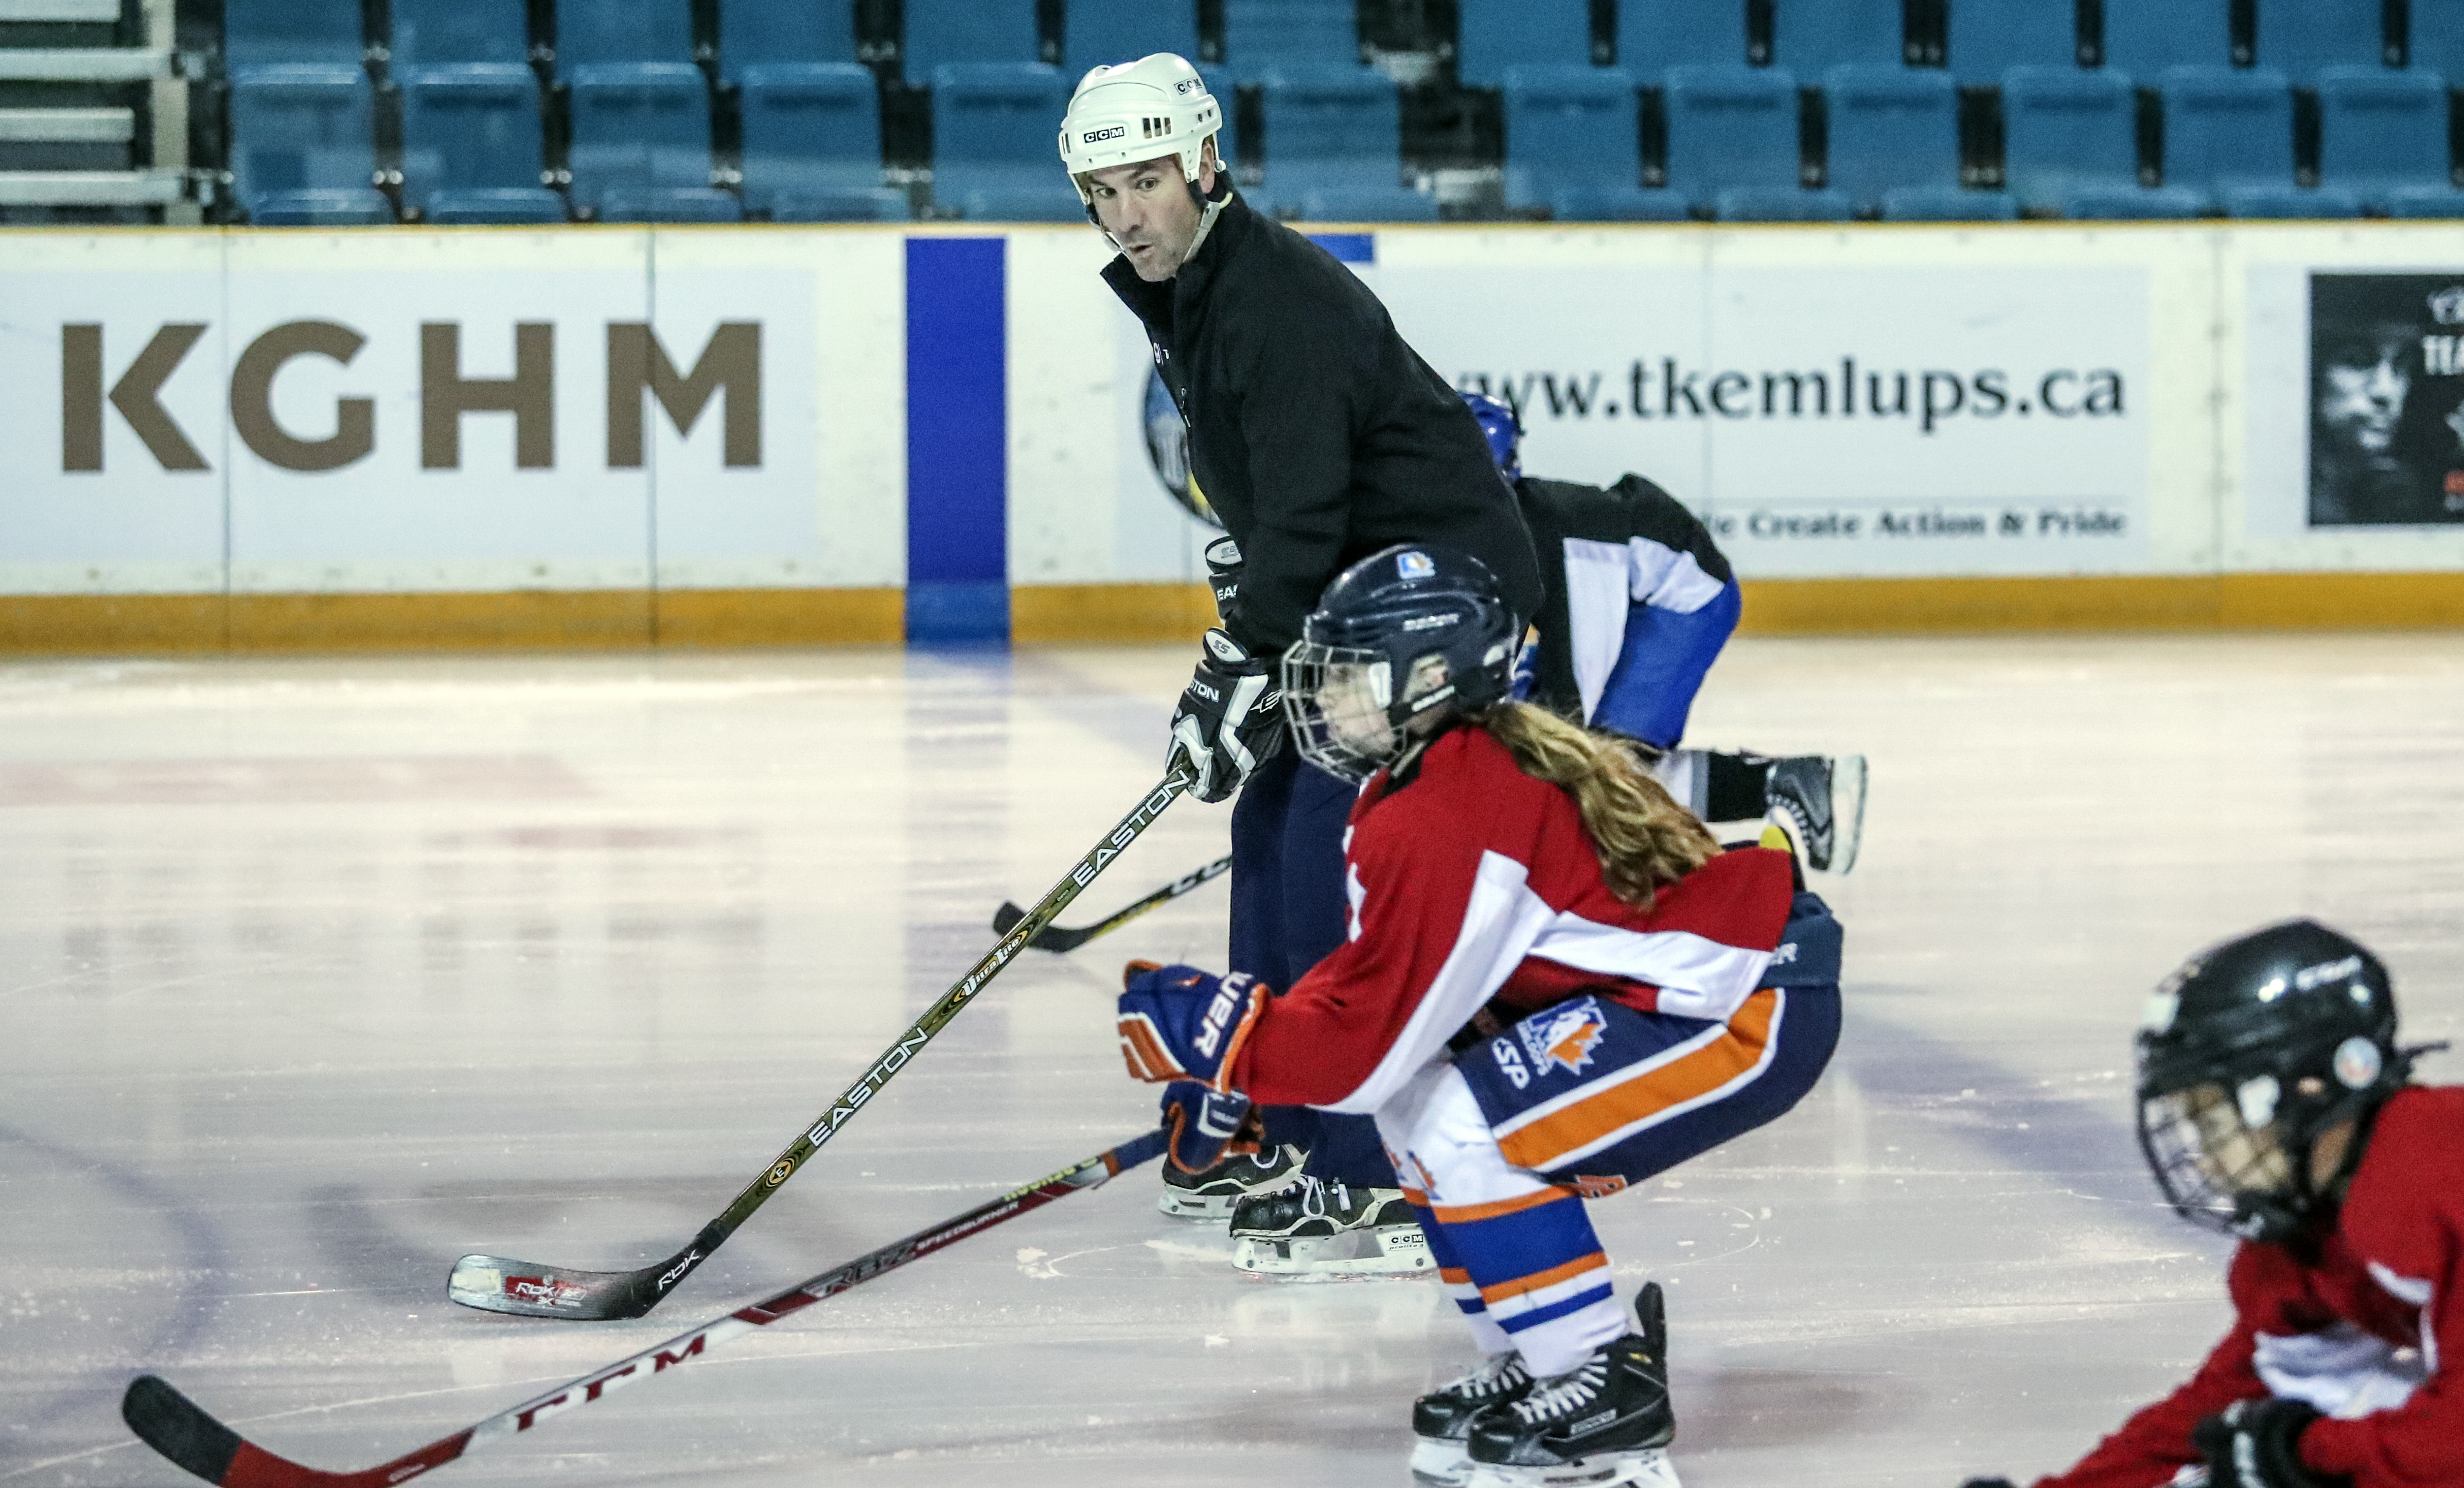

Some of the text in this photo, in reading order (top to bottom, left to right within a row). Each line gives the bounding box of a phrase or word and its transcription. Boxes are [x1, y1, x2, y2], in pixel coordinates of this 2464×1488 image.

[1174, 77, 1202, 95] CCM
[1084, 127, 1124, 144] CCM
[62, 316, 763, 472] KGHM
[1456, 356, 2125, 434] ww.tkemlups.ca
[1748, 511, 1862, 538] Create
[1874, 510, 1985, 537] Action
[2036, 509, 2127, 536] Pride
[1213, 640, 1230, 654] S5
[1072, 769, 1190, 887] EASTON
[807, 1027, 928, 1147] EASTON
[1391, 1234, 1423, 1244] CCM
